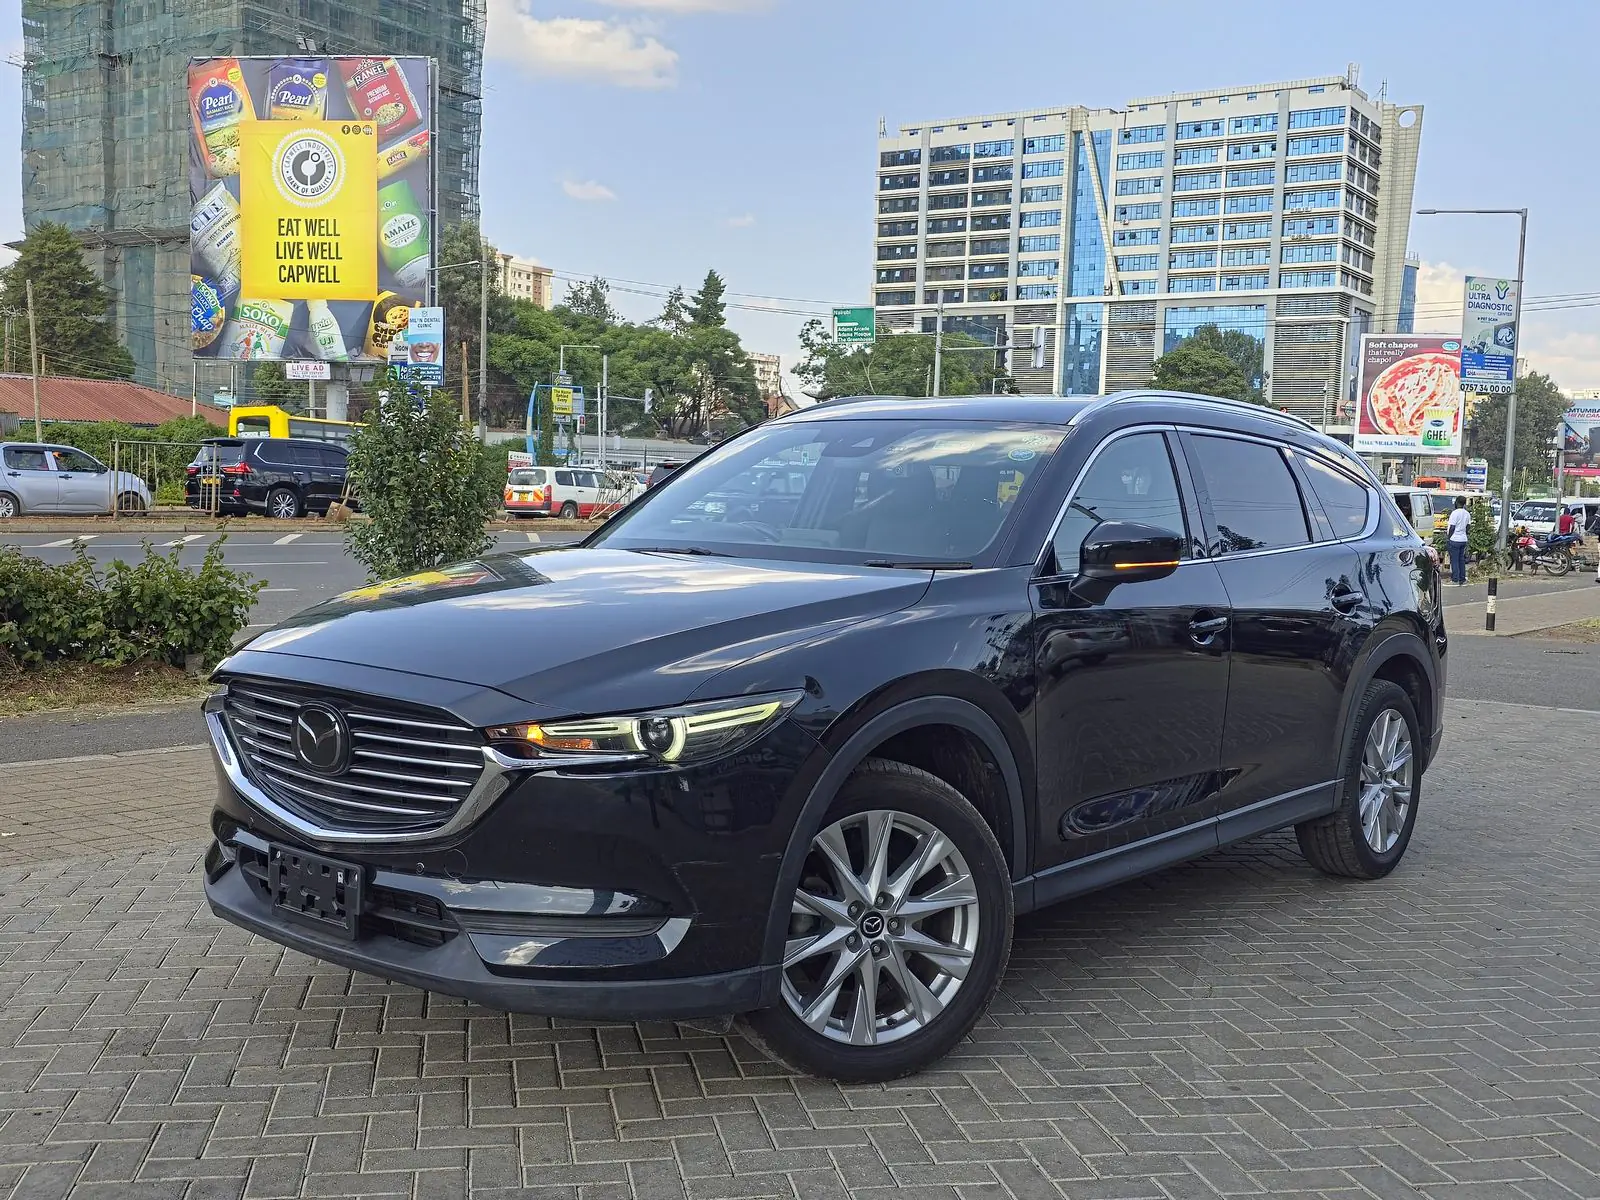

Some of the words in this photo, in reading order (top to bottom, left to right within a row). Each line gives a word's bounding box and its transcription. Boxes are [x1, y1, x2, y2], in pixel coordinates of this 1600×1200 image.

[355, 65, 384, 84] RANEE
[202, 90, 235, 109] Pearl
[279, 90, 313, 106] Pearl
[286, 175, 299, 191] MARK
[310, 176, 331, 194] QUALITY
[278, 218, 301, 236] EAT
[305, 218, 340, 236] WELL
[384, 218, 417, 240] AMAIZE
[276, 241, 304, 259] LIVE
[307, 241, 343, 260] WELL
[278, 264, 340, 283] CAPWELL
[1469, 283, 1486, 291] UDC
[1468, 302, 1513, 311] DIAGNOSTIC
[241, 306, 281, 327] SOKO
[320, 336, 334, 346] UJI
[1388, 341, 1419, 350] chapos
[1367, 356, 1392, 365] chapo!
[1460, 384, 1478, 392] 0757
[1479, 384, 1489, 392] 34
[1427, 430, 1448, 440] GHEE
